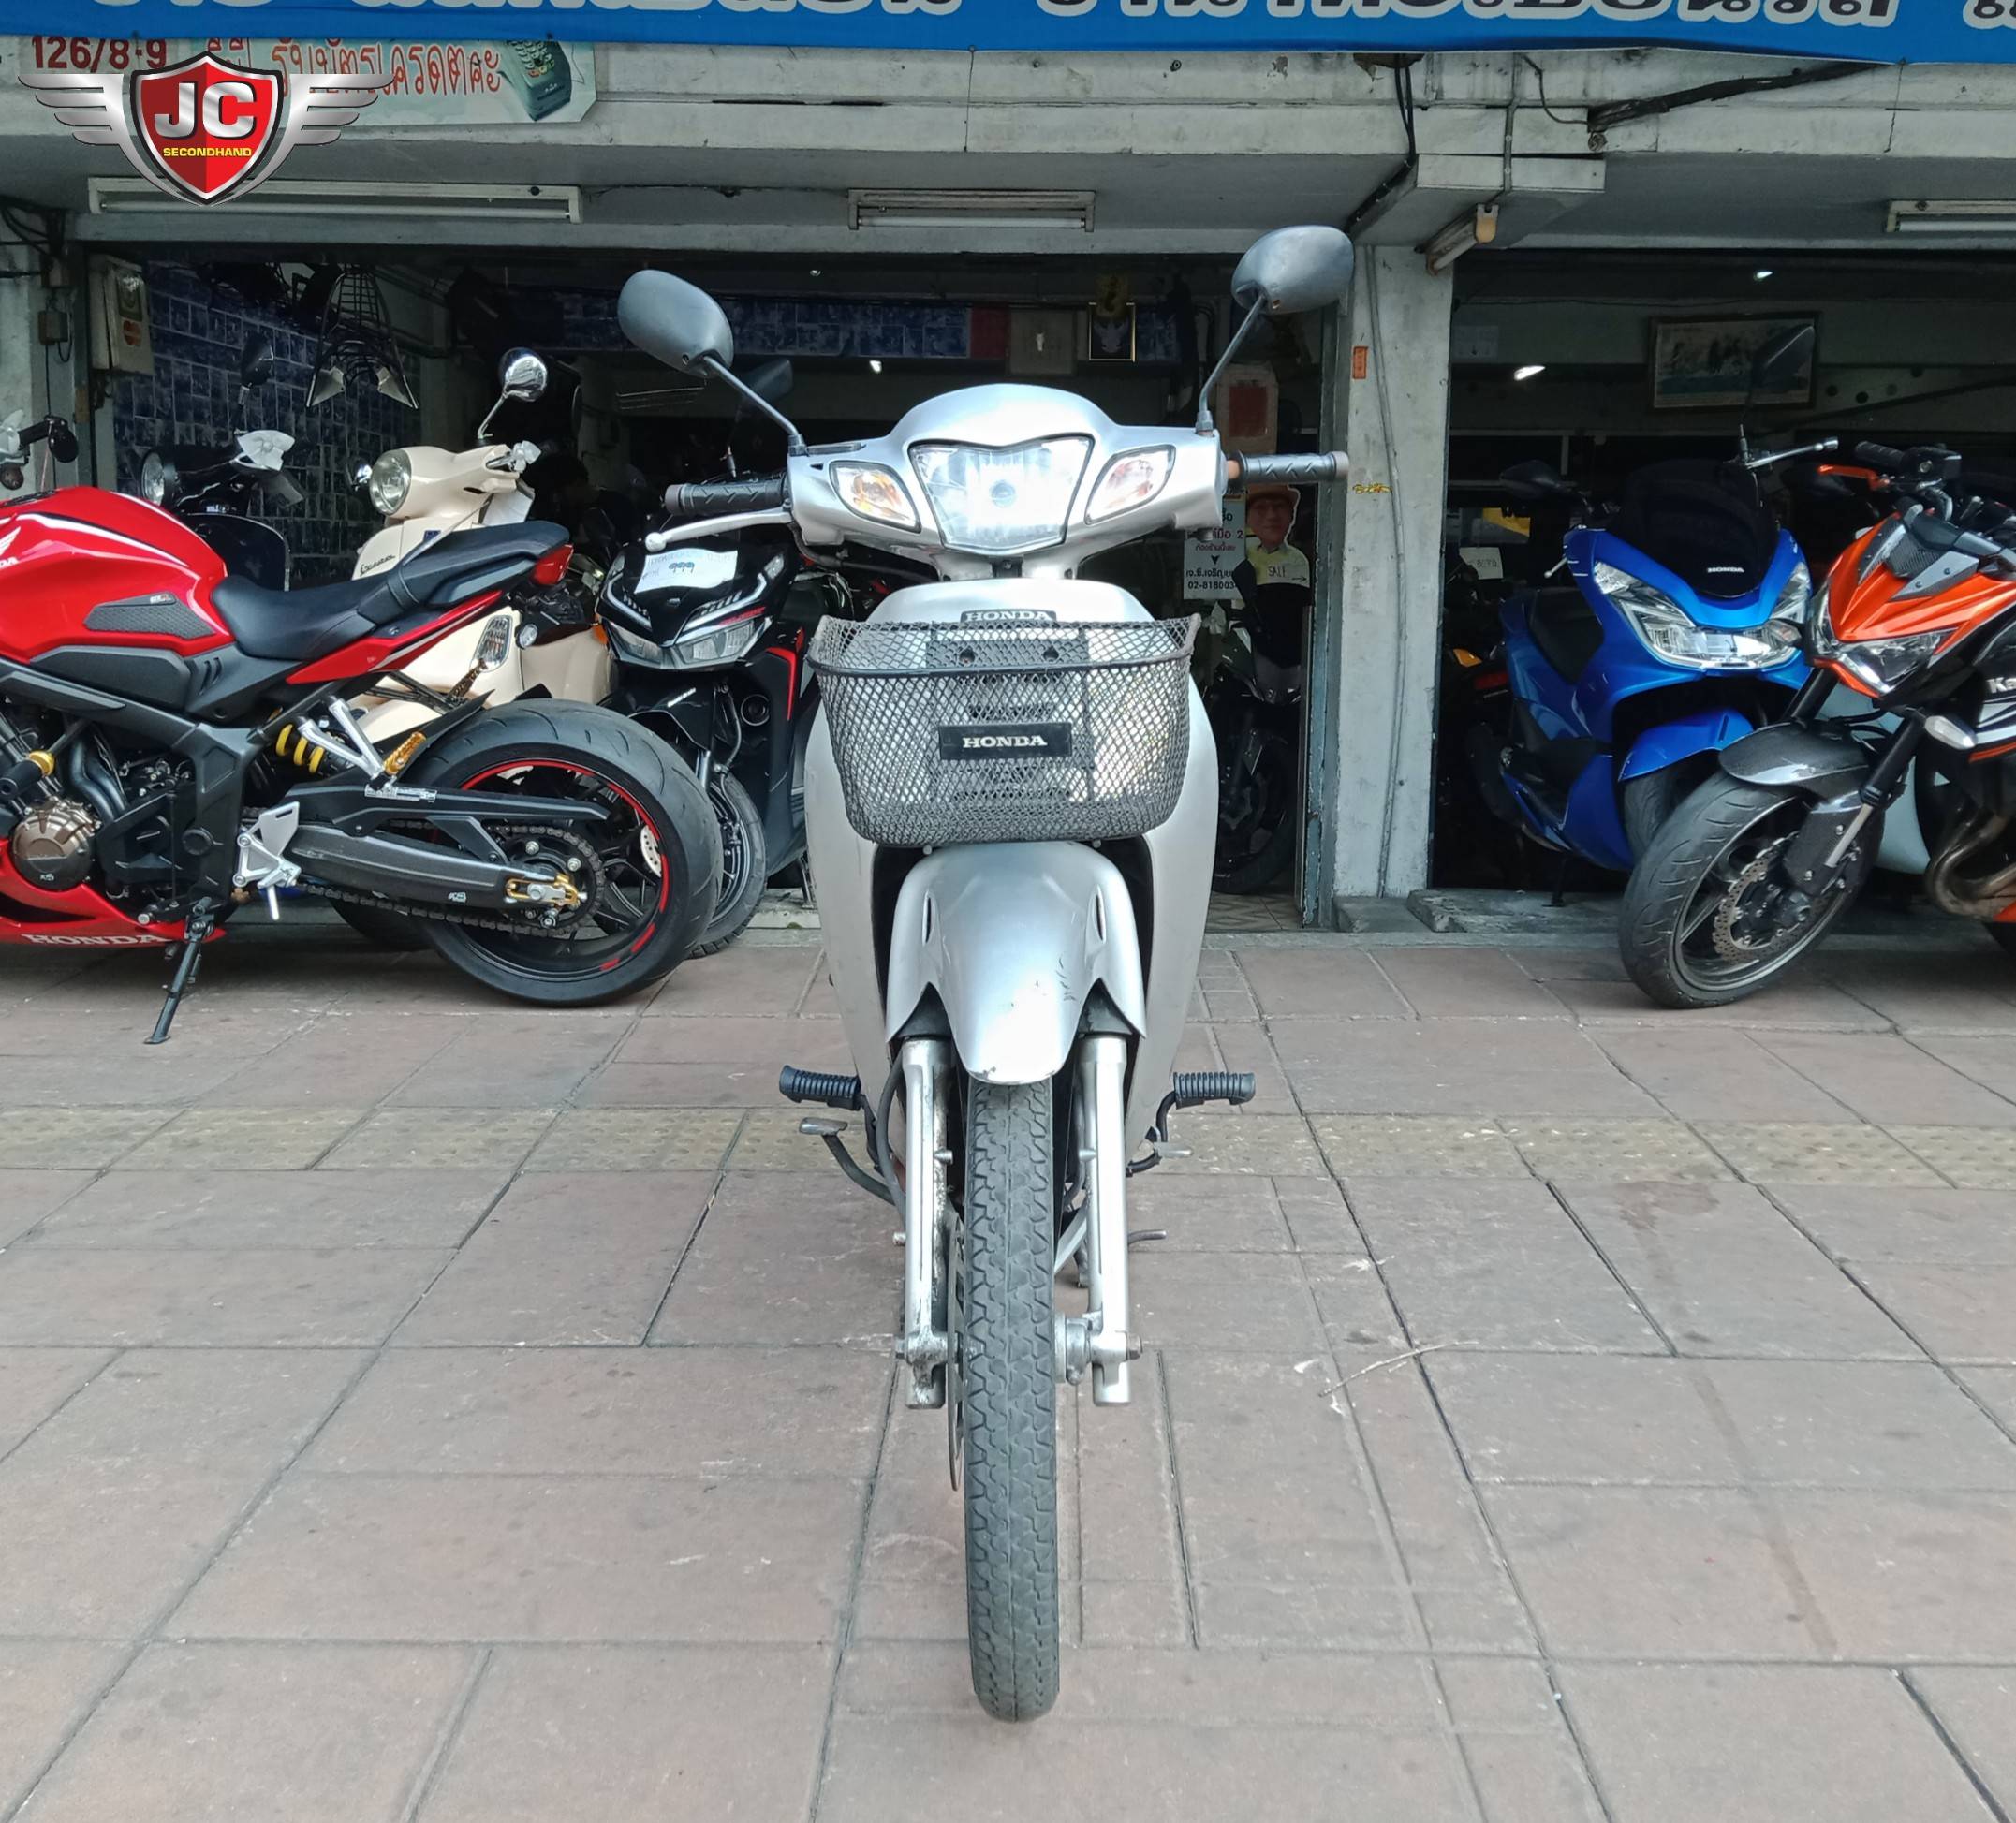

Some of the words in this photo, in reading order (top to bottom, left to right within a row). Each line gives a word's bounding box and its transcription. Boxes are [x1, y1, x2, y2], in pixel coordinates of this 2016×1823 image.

[1187, 581, 1235, 590] 02-818003
[964, 610, 1053, 622] HONDA
[962, 734, 1049, 749] HONDA
[21, 933, 173, 945] HONDA
